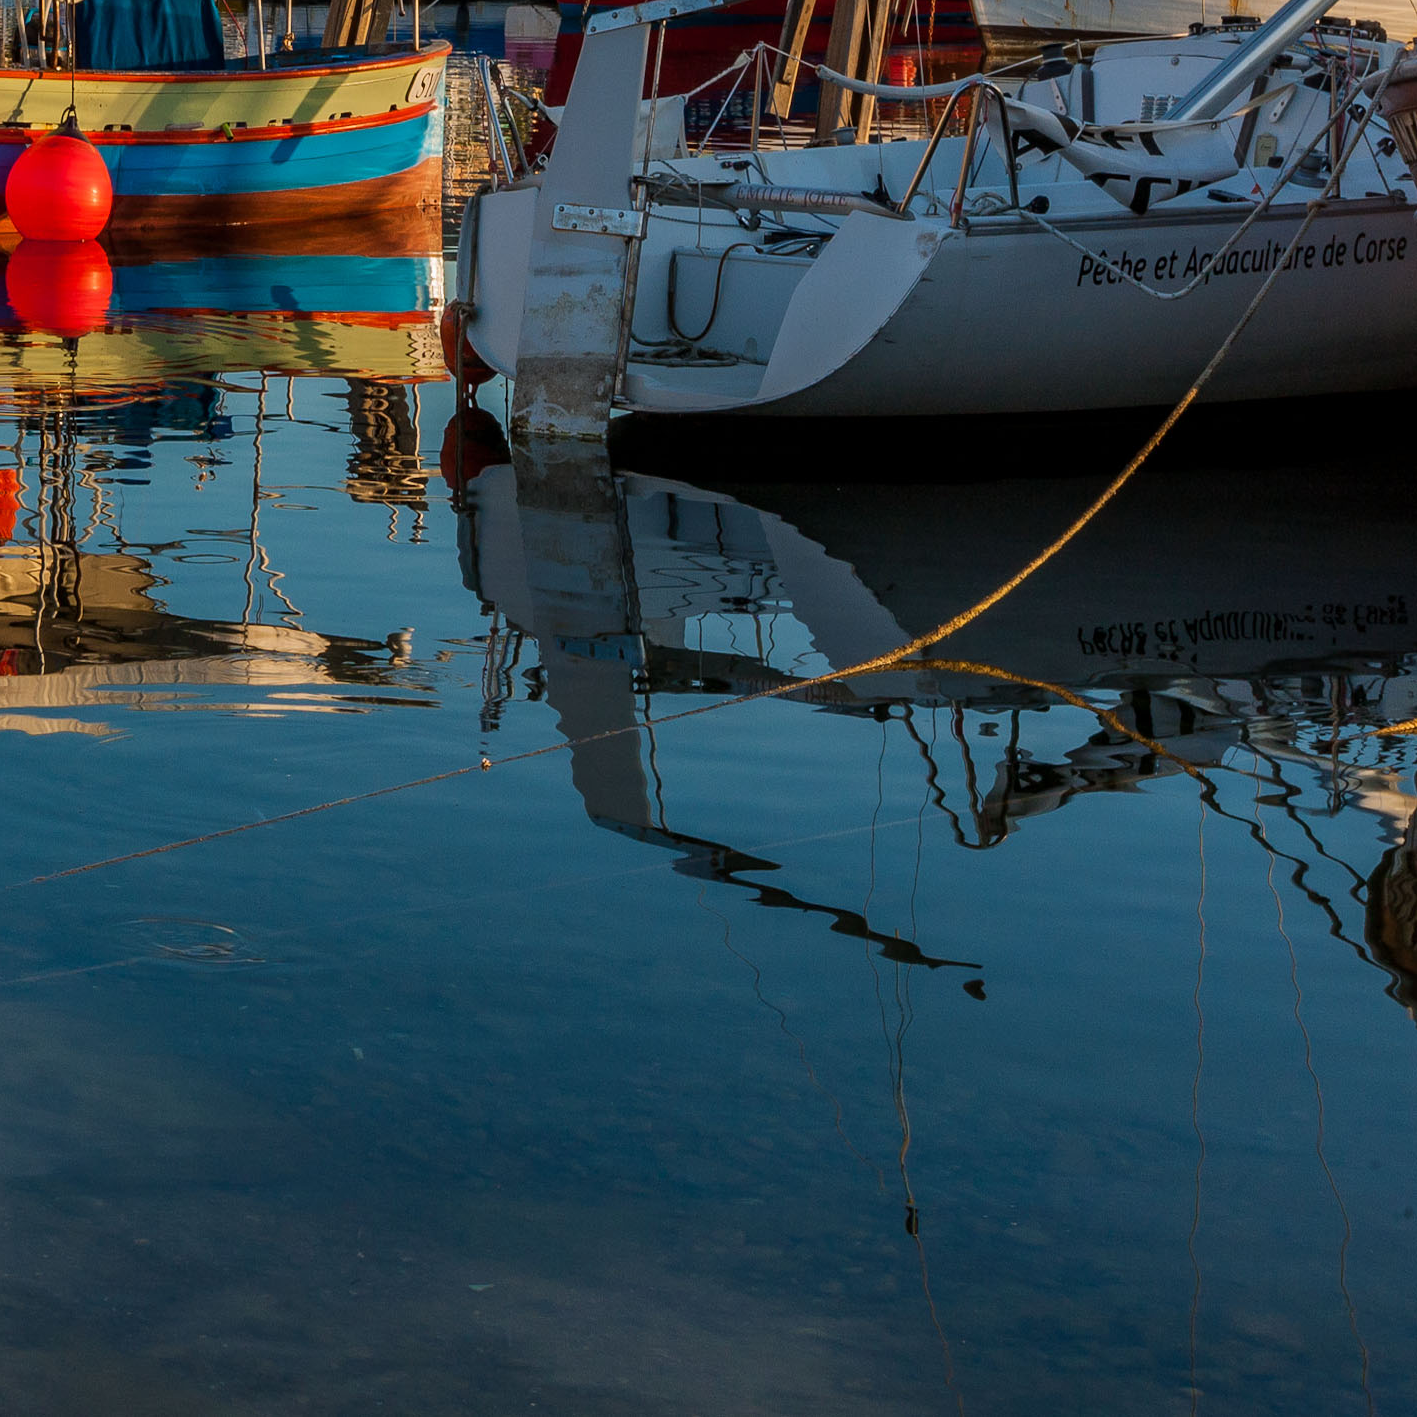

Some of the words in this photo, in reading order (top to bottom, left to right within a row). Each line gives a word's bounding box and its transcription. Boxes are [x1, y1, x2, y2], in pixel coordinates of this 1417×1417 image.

[736, 185, 795, 203] EMILIE
[1077, 249, 1147, 287] Pêche
[1154, 250, 1179, 281] et
[1183, 238, 1316, 286] Aquaculture
[1322, 234, 1348, 267] de
[1353, 231, 1408, 265] Corse
